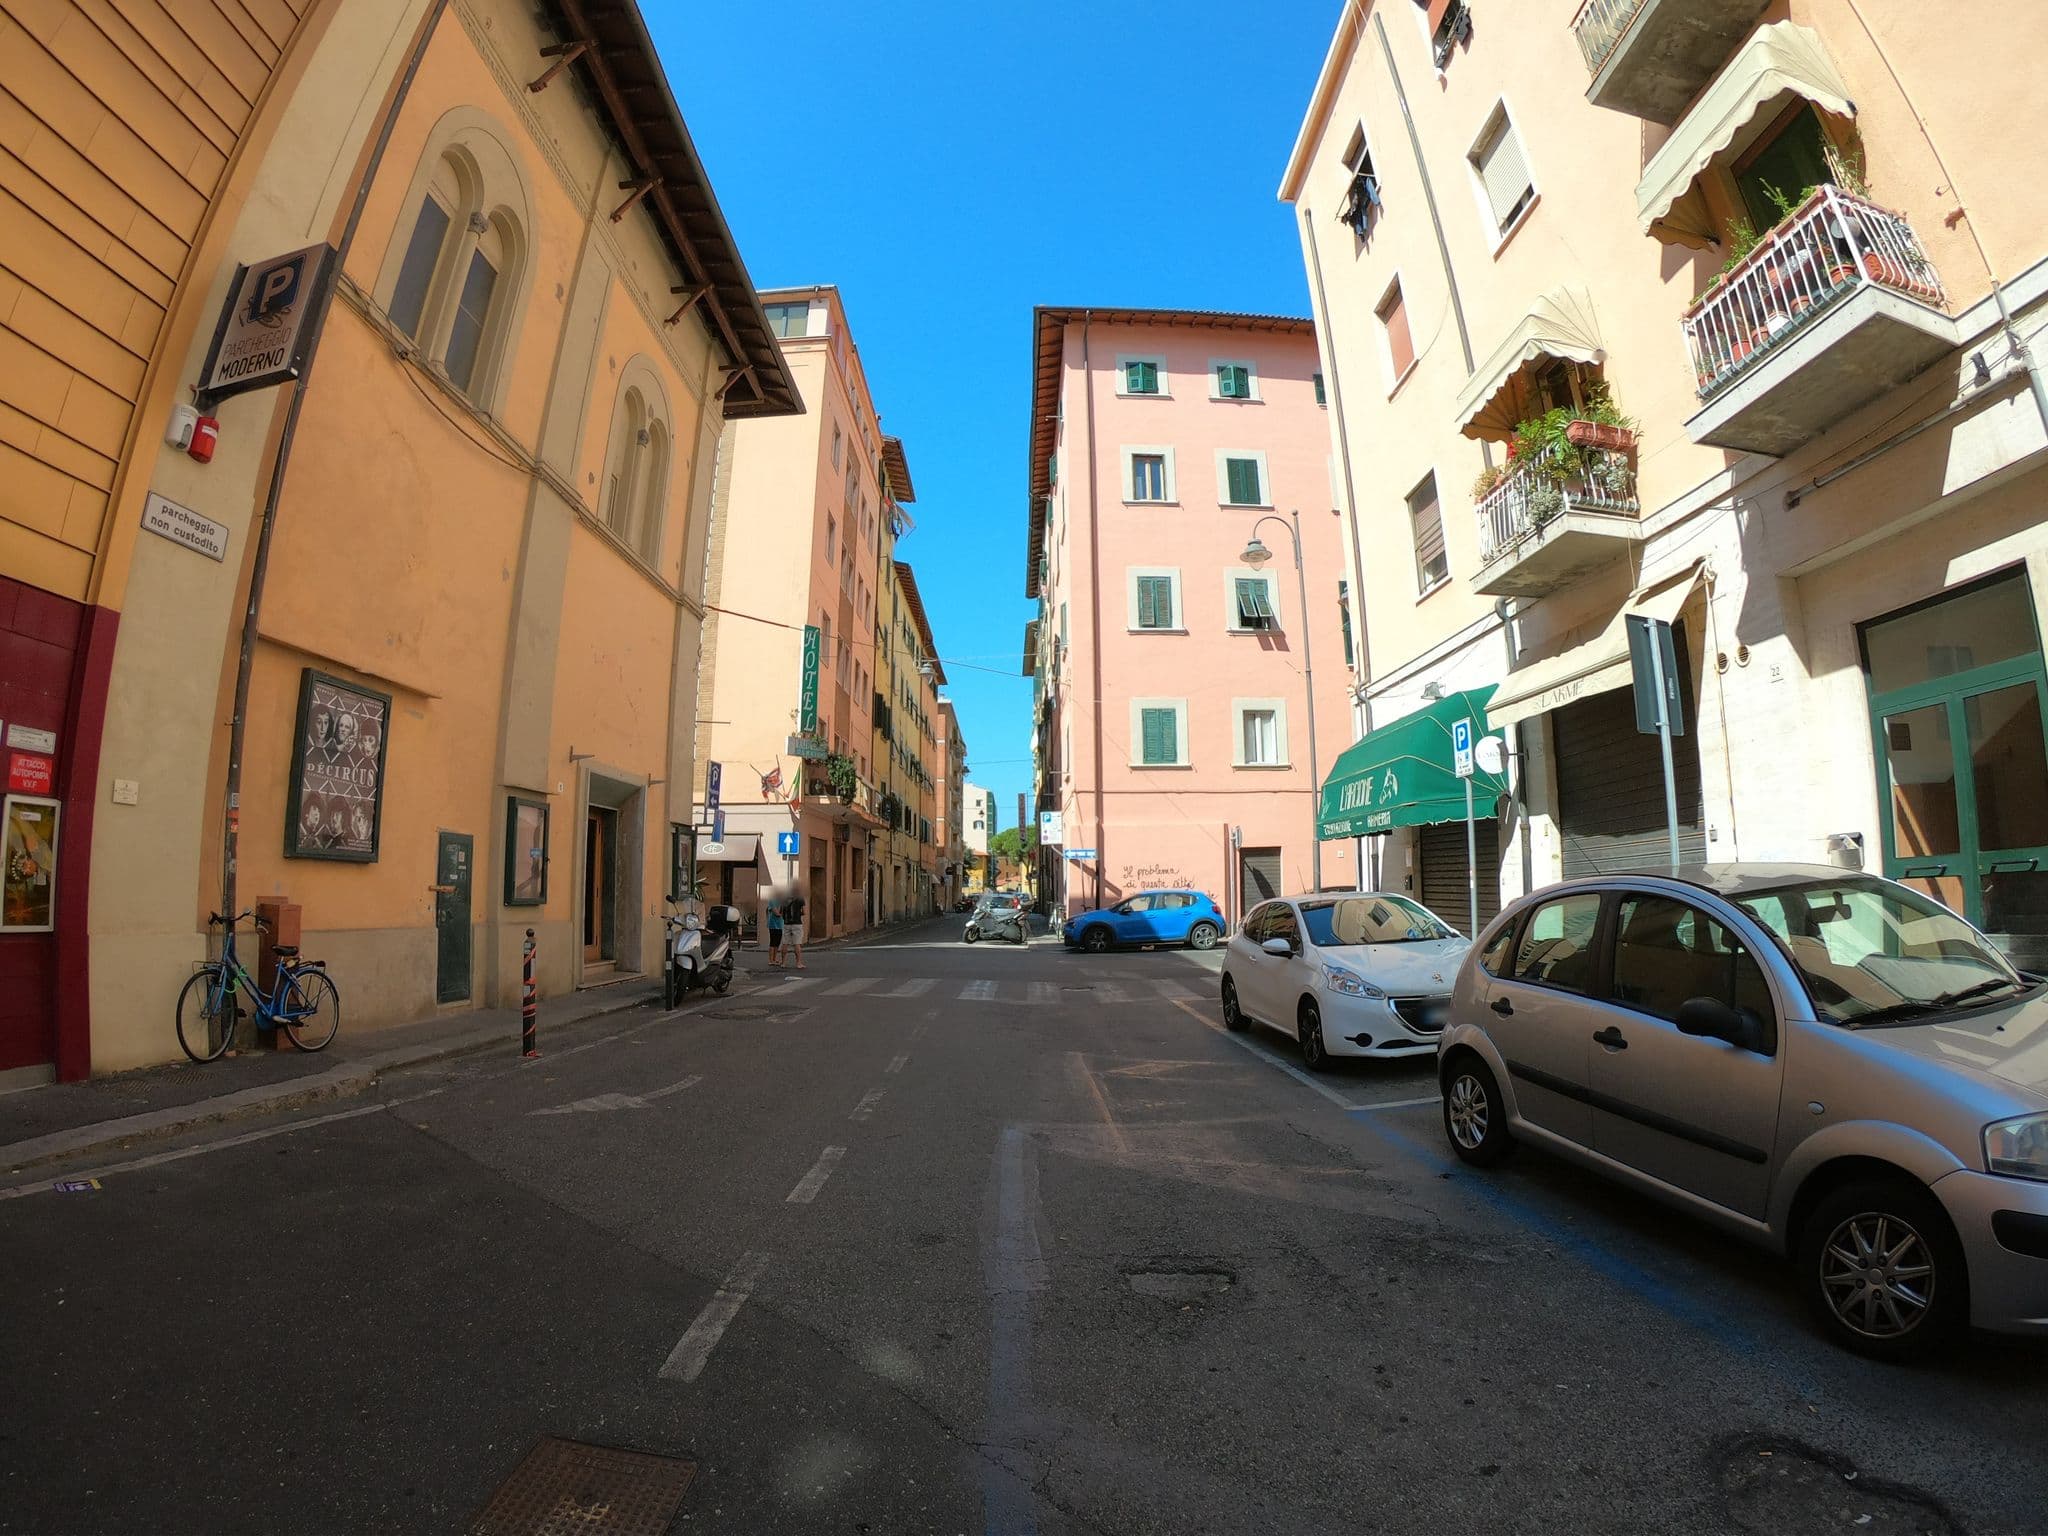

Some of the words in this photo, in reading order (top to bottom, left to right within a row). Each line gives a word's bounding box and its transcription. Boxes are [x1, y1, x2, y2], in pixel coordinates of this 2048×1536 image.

[259, 265, 294, 319] P
[223, 327, 292, 358] PARCHEGGIO
[218, 348, 285, 382] MODERNO
[161, 505, 215, 536] parcheggio
[150, 516, 170, 531] non
[173, 527, 219, 553] custodito
[803, 629, 819, 732] HOTEL
[1457, 726, 1466, 749] P
[12, 768, 49, 780] AUTOPOMPA
[17, 759, 46, 769] ATTACCO
[307, 762, 375, 787] DÉCIRCUS
[1366, 811, 1391, 828] ARMERIA
[1123, 880, 1137, 889] di
[1137, 864, 1180, 880] problema
